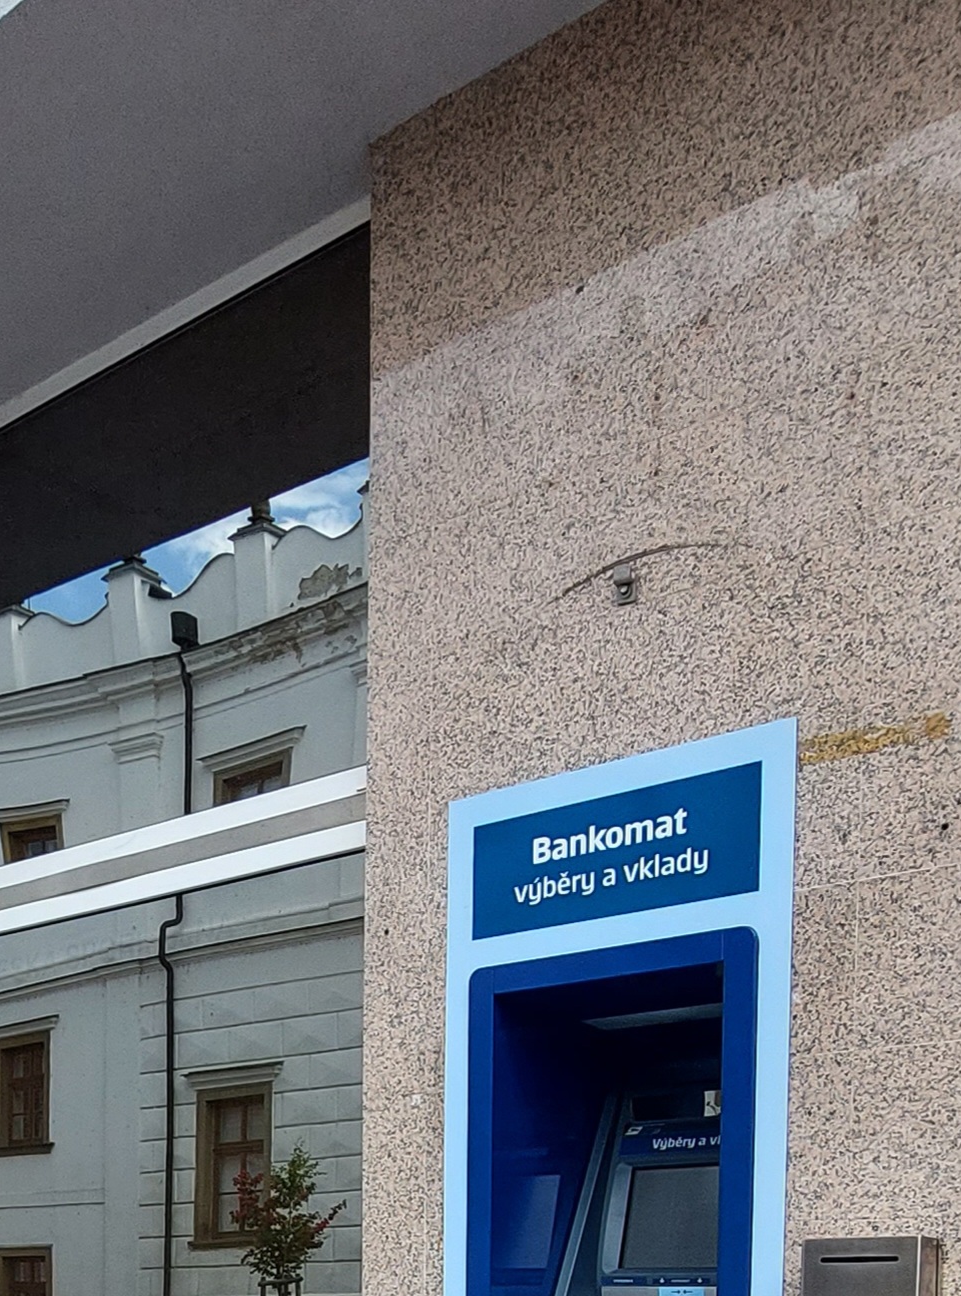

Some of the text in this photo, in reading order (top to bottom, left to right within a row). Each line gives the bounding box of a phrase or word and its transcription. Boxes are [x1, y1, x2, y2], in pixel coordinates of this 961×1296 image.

[532, 807, 689, 865] Bankomat
[514, 847, 709, 905] výběry a vklady
[652, 1136, 696, 1151] Výběry
[698, 1137, 707, 1147] a
